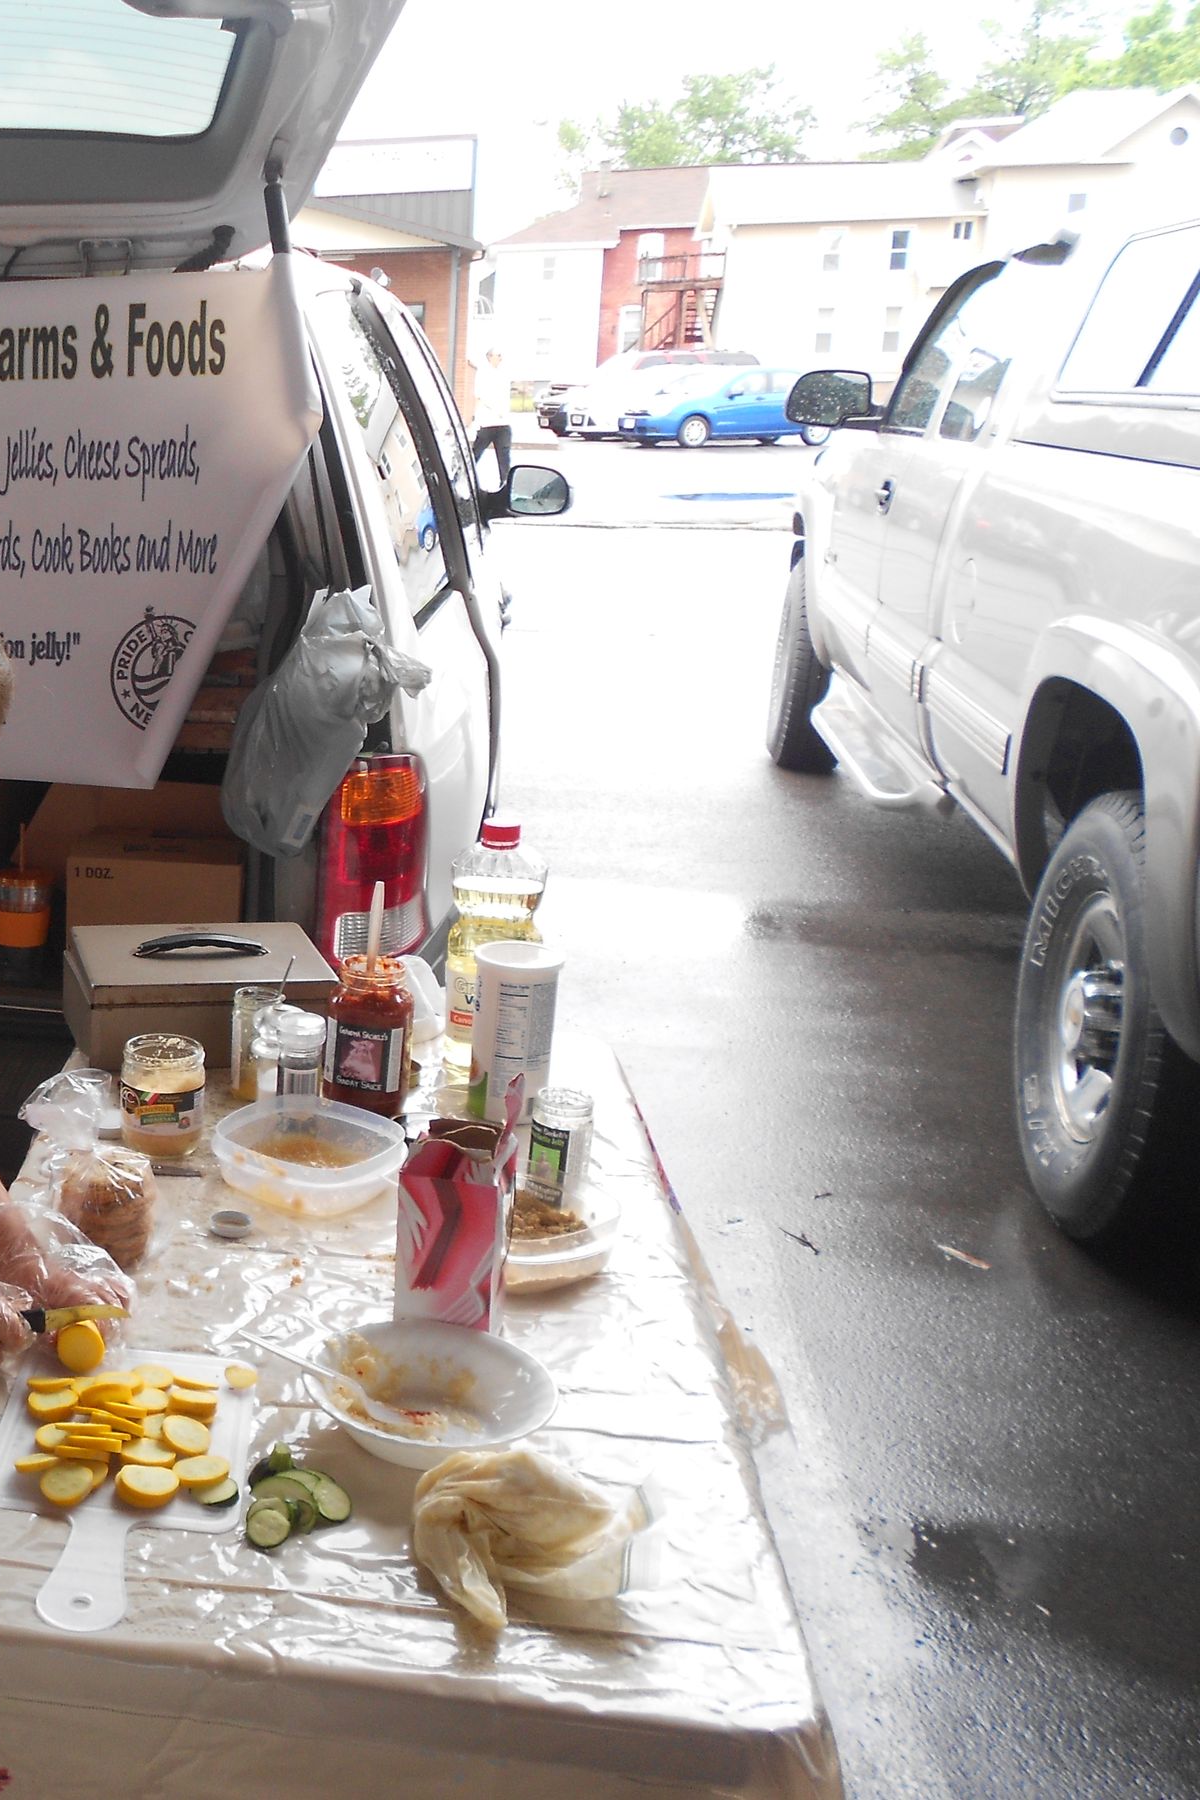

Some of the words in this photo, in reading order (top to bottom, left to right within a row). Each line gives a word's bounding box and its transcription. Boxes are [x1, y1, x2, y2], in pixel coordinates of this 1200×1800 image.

[90, 303, 114, 379] &
[127, 300, 227, 377] Foods
[64, 428, 121, 481] Cheese
[124, 423, 200, 502] Spreads,
[31, 522, 74, 574] Cook
[77, 522, 131, 575] Books
[136, 519, 172, 573] and
[175, 529, 218, 574] More
[116, 629, 148, 681] PRIDE
[130, 702, 154, 726] NE
[75, 867, 80, 877] 1
[85, 867, 114, 879] DOZ.
[453, 1014, 472, 1025] Cano
